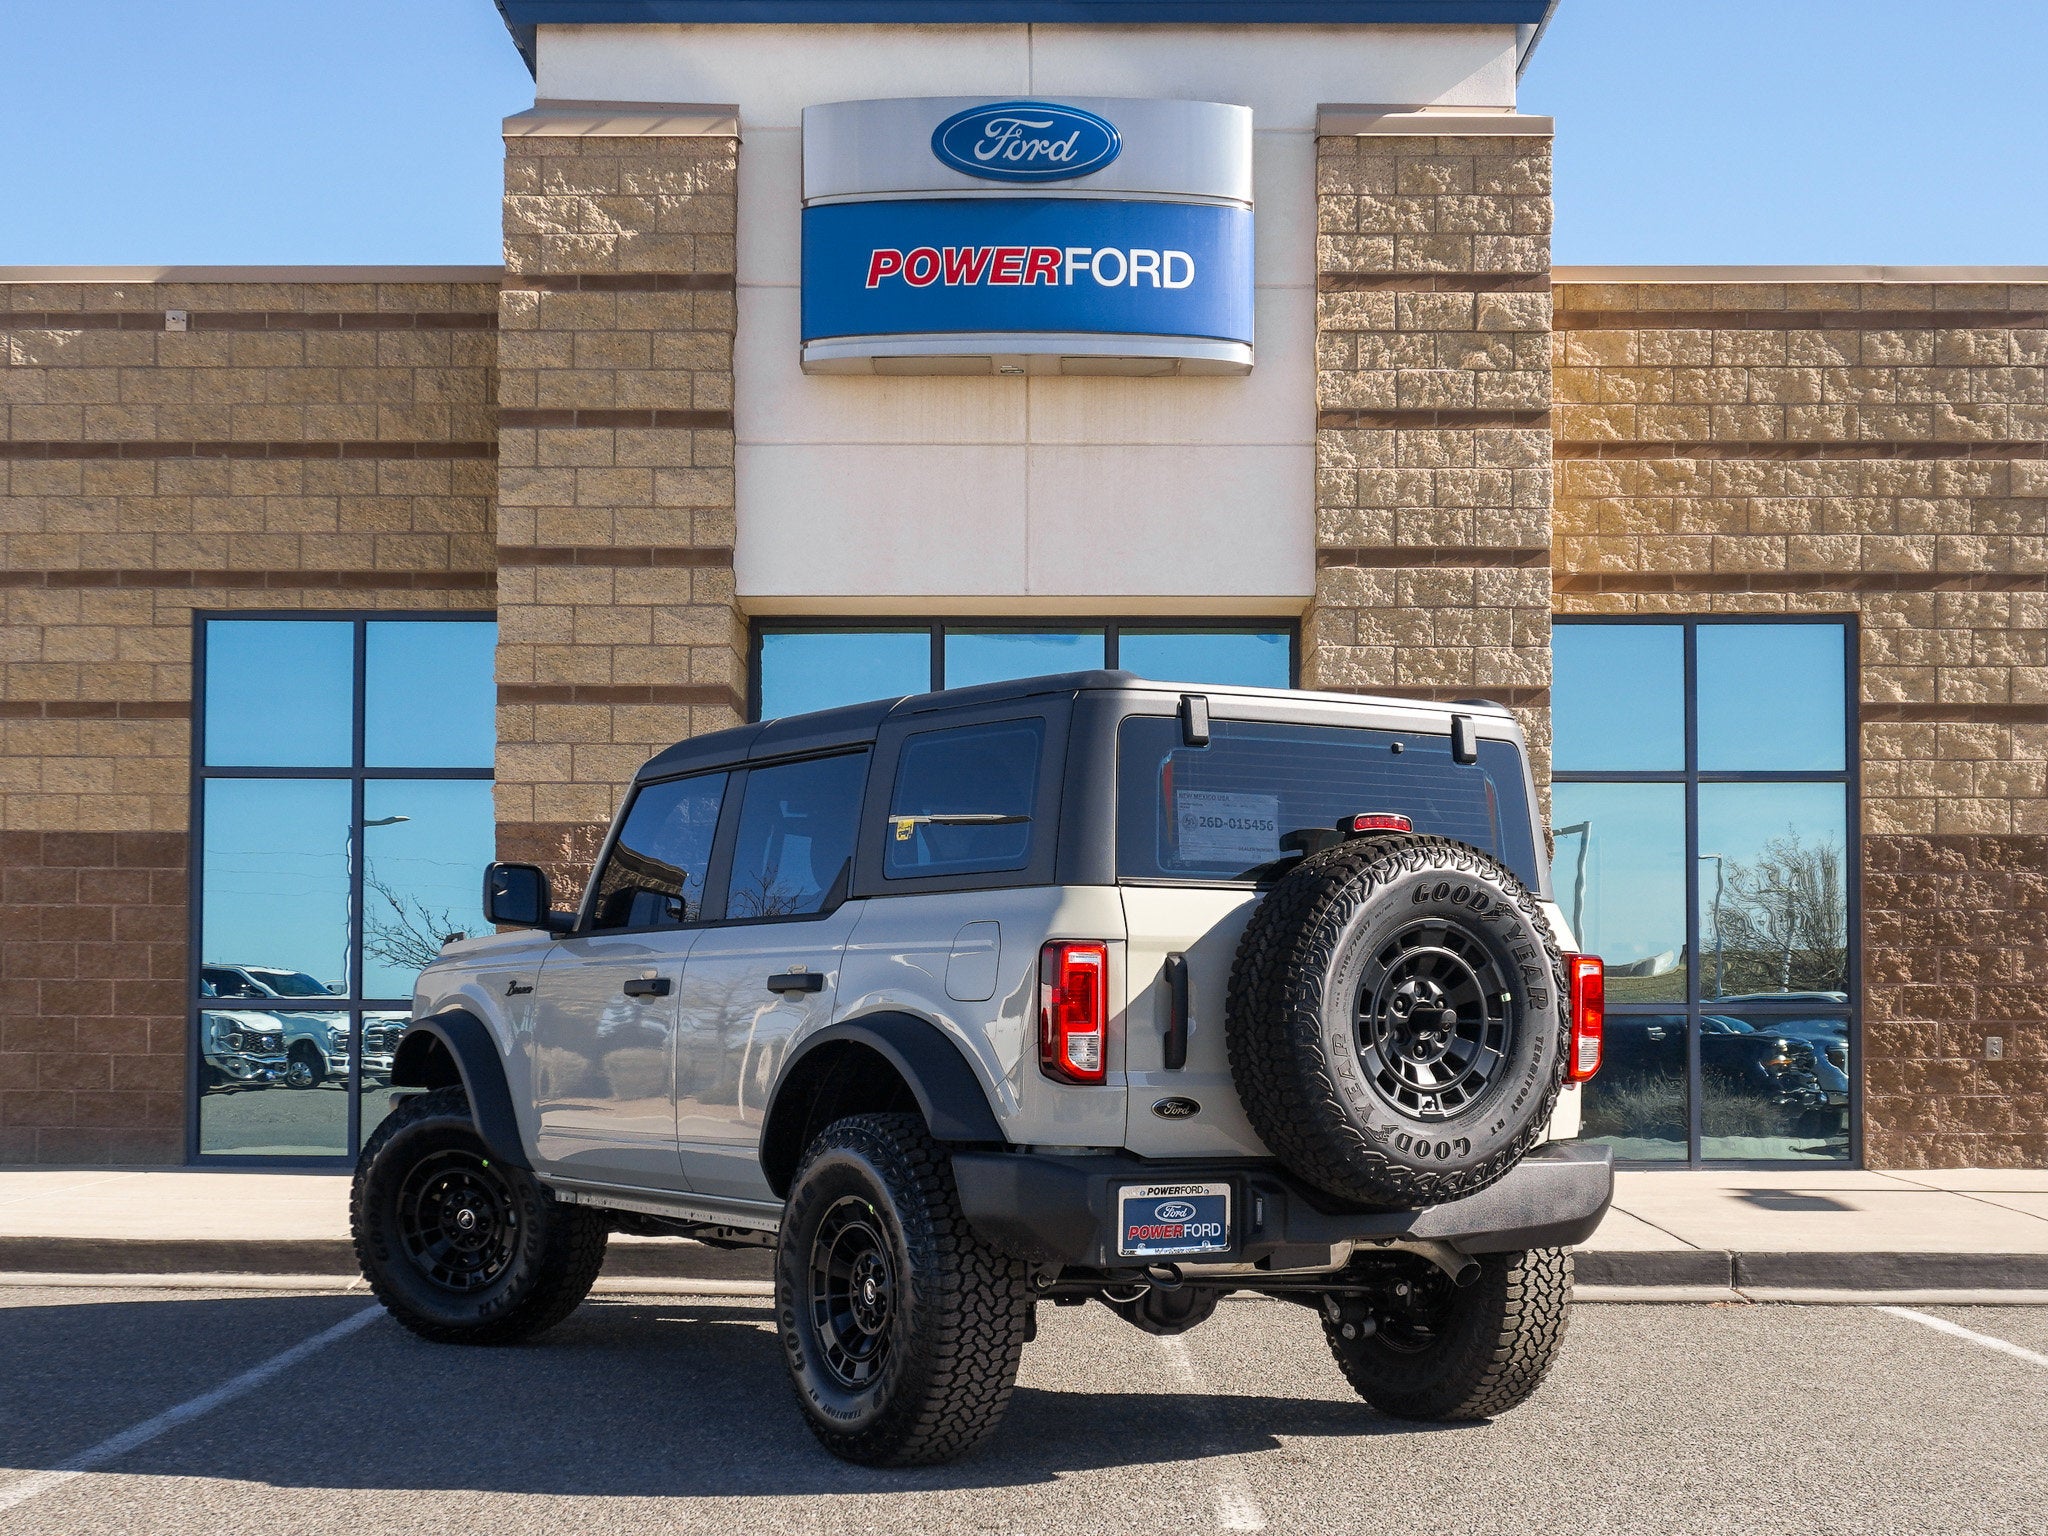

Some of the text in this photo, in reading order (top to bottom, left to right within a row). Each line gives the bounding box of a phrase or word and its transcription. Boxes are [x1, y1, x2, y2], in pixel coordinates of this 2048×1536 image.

[974, 118, 1080, 162] Ford
[865, 246, 1195, 289] POWERFORD
[1200, 816, 1274, 831] 26D-015456
[1490, 1036, 1545, 1136] TERRITORY RT
[1163, 1101, 1190, 1115] Ford
[1147, 1185, 1204, 1196] POWERFORD
[1162, 1205, 1188, 1218] Ford
[1128, 1222, 1221, 1240] POWERFORD
